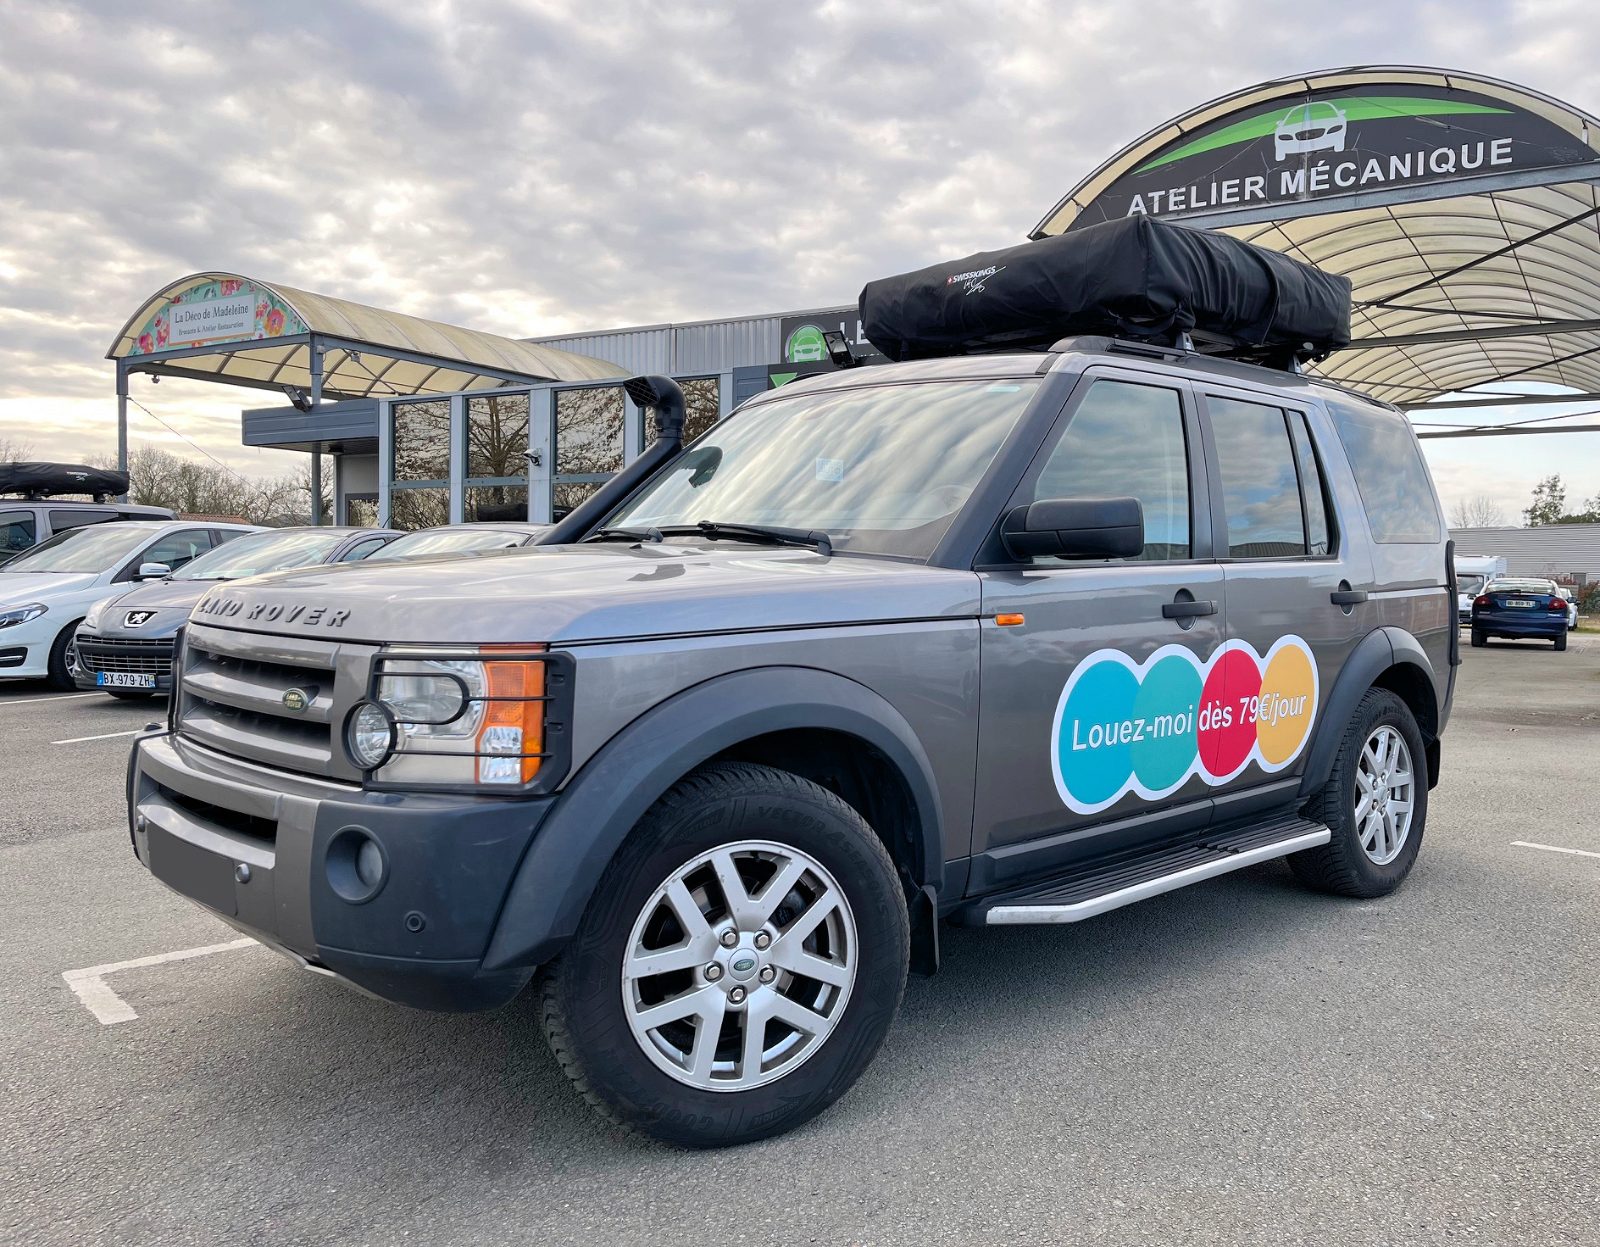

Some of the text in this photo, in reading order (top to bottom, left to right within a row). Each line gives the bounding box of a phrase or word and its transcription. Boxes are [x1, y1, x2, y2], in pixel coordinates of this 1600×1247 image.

[1127, 137, 1514, 217] ATELIER MÉCANIQUE
[953, 265, 996, 283] SWISSKINGS
[175, 312, 184, 324] La
[202, 308, 211, 320] de
[212, 304, 249, 318] Madeleine
[198, 597, 351, 628] LAND ROVER
[103, 673, 150, 687] BX-979-ZH
[1072, 691, 1307, 751] Louez-moi dès 79€/jour
